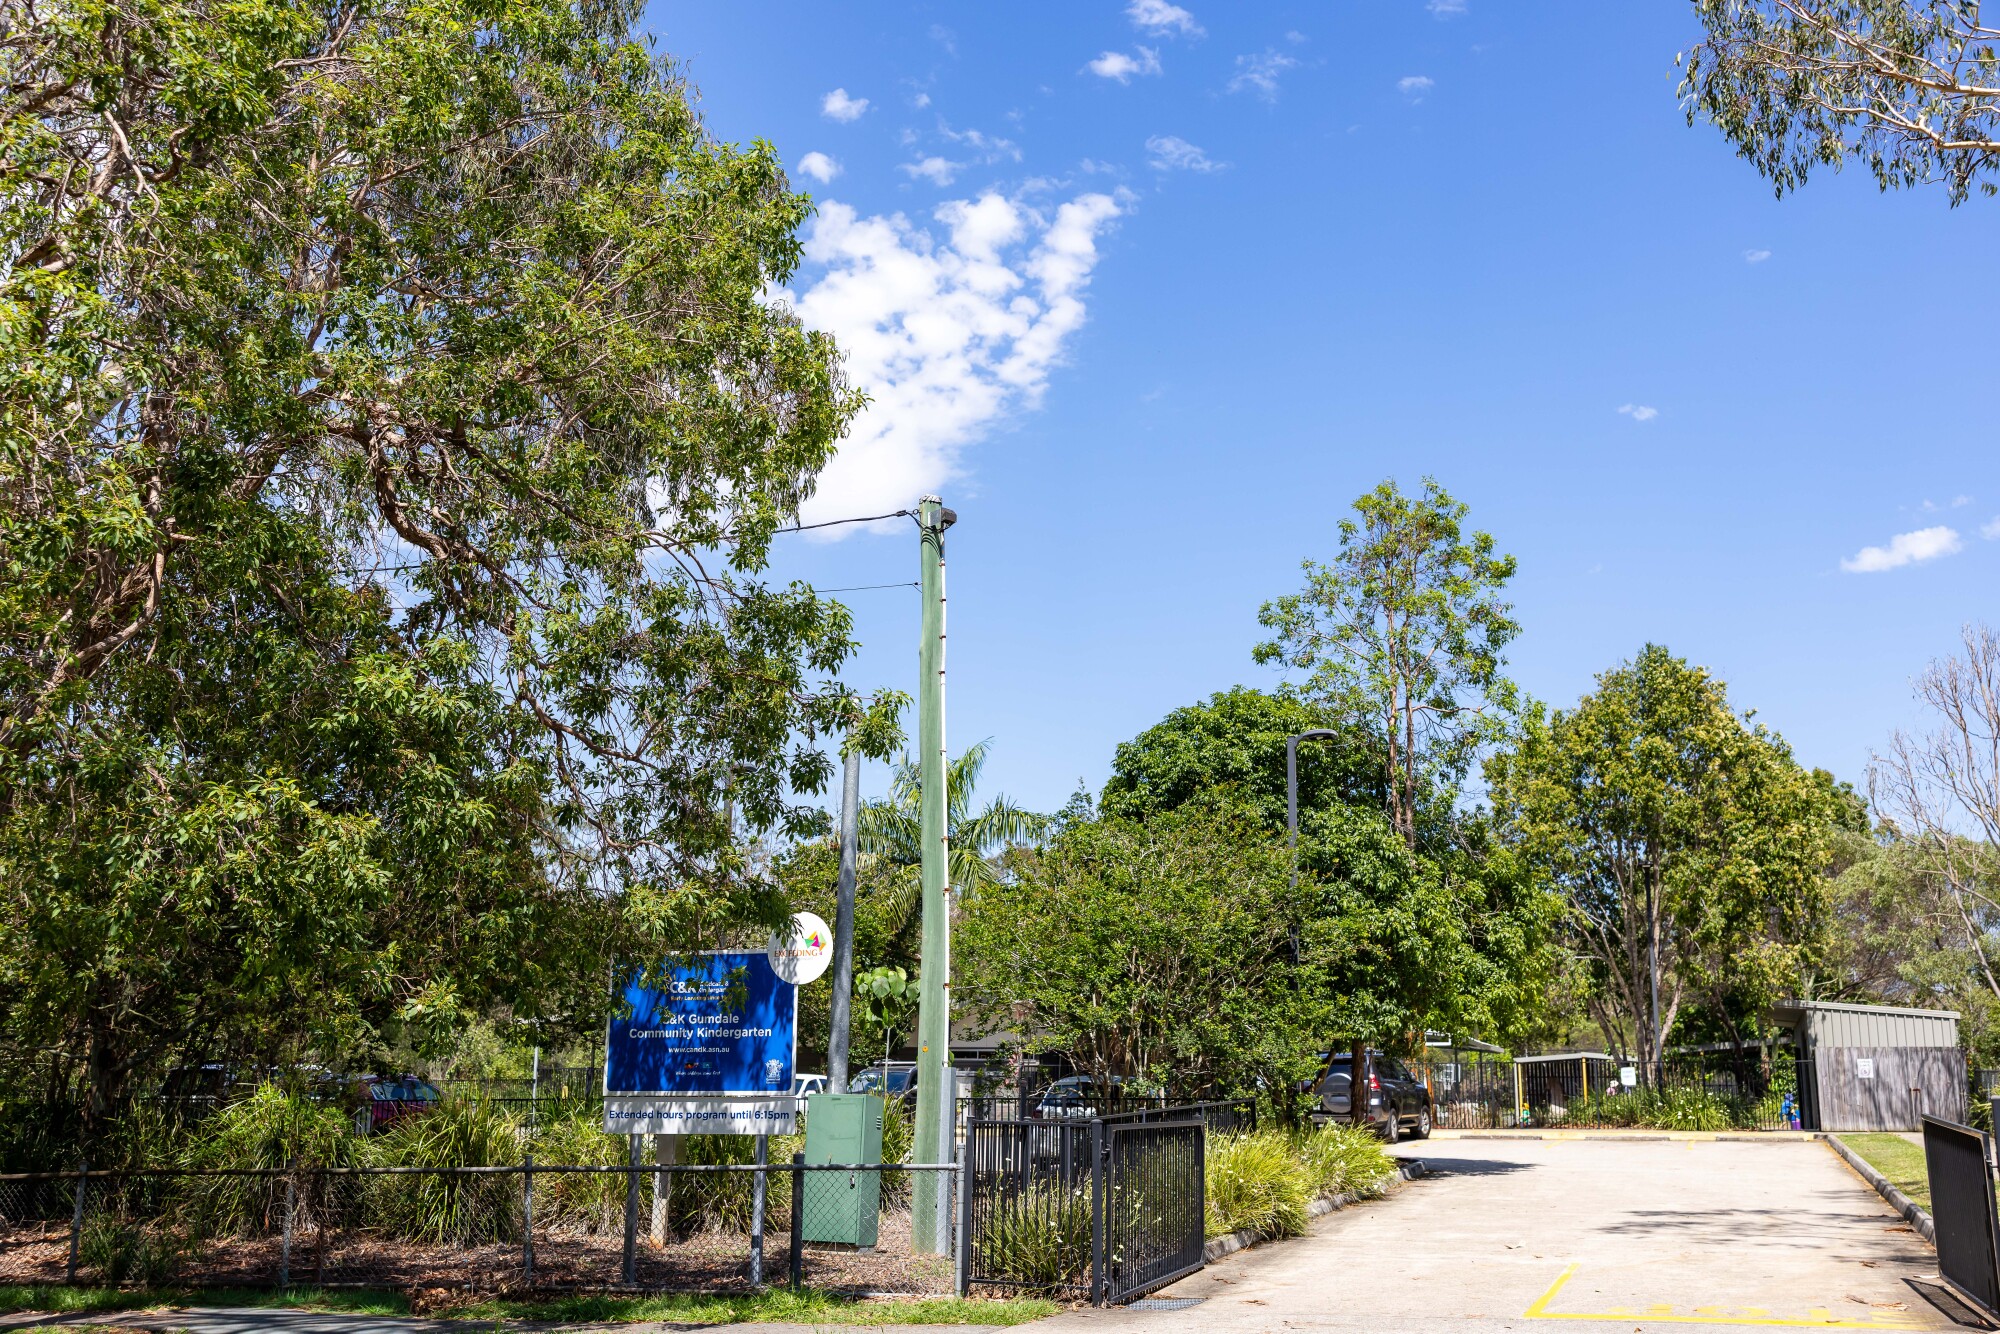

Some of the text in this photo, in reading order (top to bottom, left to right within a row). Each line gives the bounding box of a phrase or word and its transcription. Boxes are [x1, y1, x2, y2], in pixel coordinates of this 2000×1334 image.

[774, 949, 818, 957] EXCEEDING
[688, 1013, 739, 1024] Gumdale
[629, 1027, 772, 1039] Community Kindergarten
[609, 1110, 790, 1121] Extended hours program until 6:15pm
